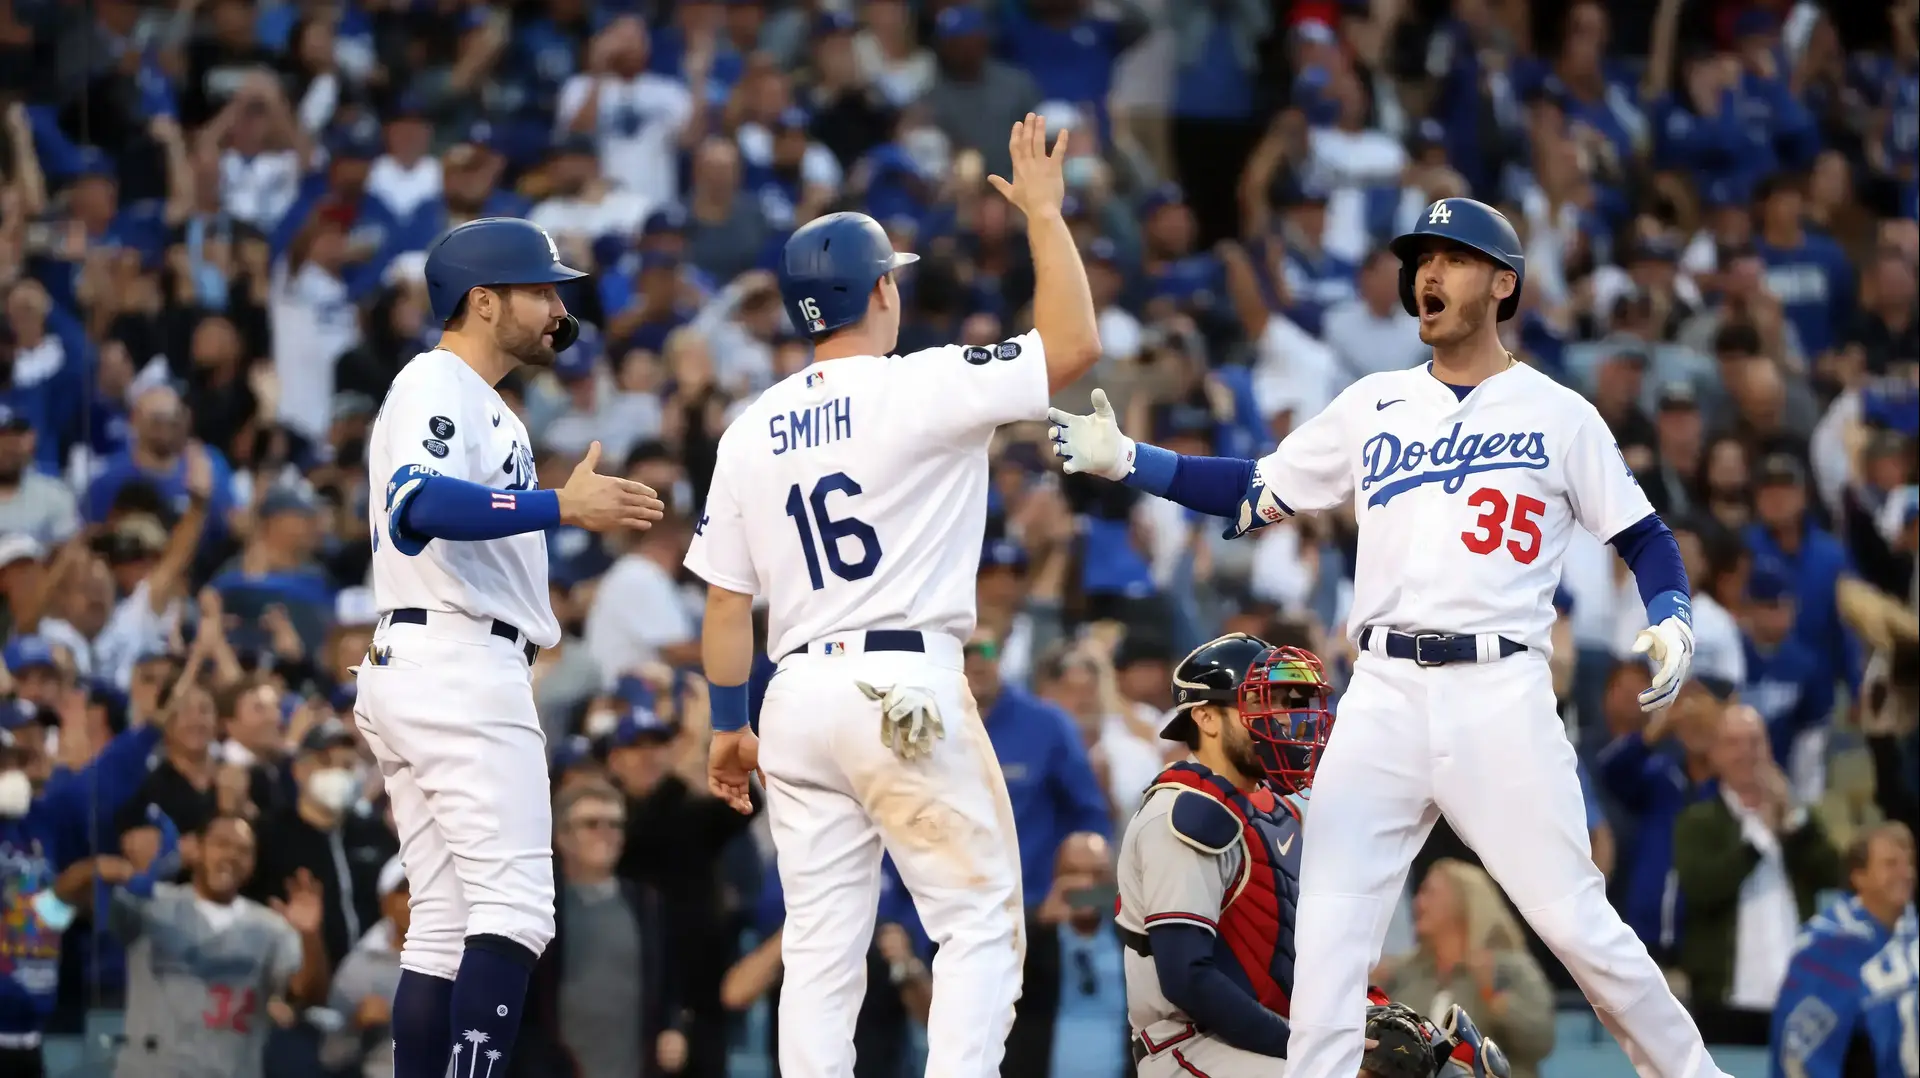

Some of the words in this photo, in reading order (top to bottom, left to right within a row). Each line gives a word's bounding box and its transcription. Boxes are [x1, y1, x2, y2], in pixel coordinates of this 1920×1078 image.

[1428, 199, 1452, 225] LA
[798, 296, 821, 321] 16
[436, 422, 447, 436] 2
[769, 396, 852, 456] SMITH
[1362, 421, 1550, 511] Dodgers
[491, 492, 516, 510] 11
[1261, 506, 1284, 521] 35
[785, 471, 883, 591] 16
[1460, 487, 1547, 565] 35
